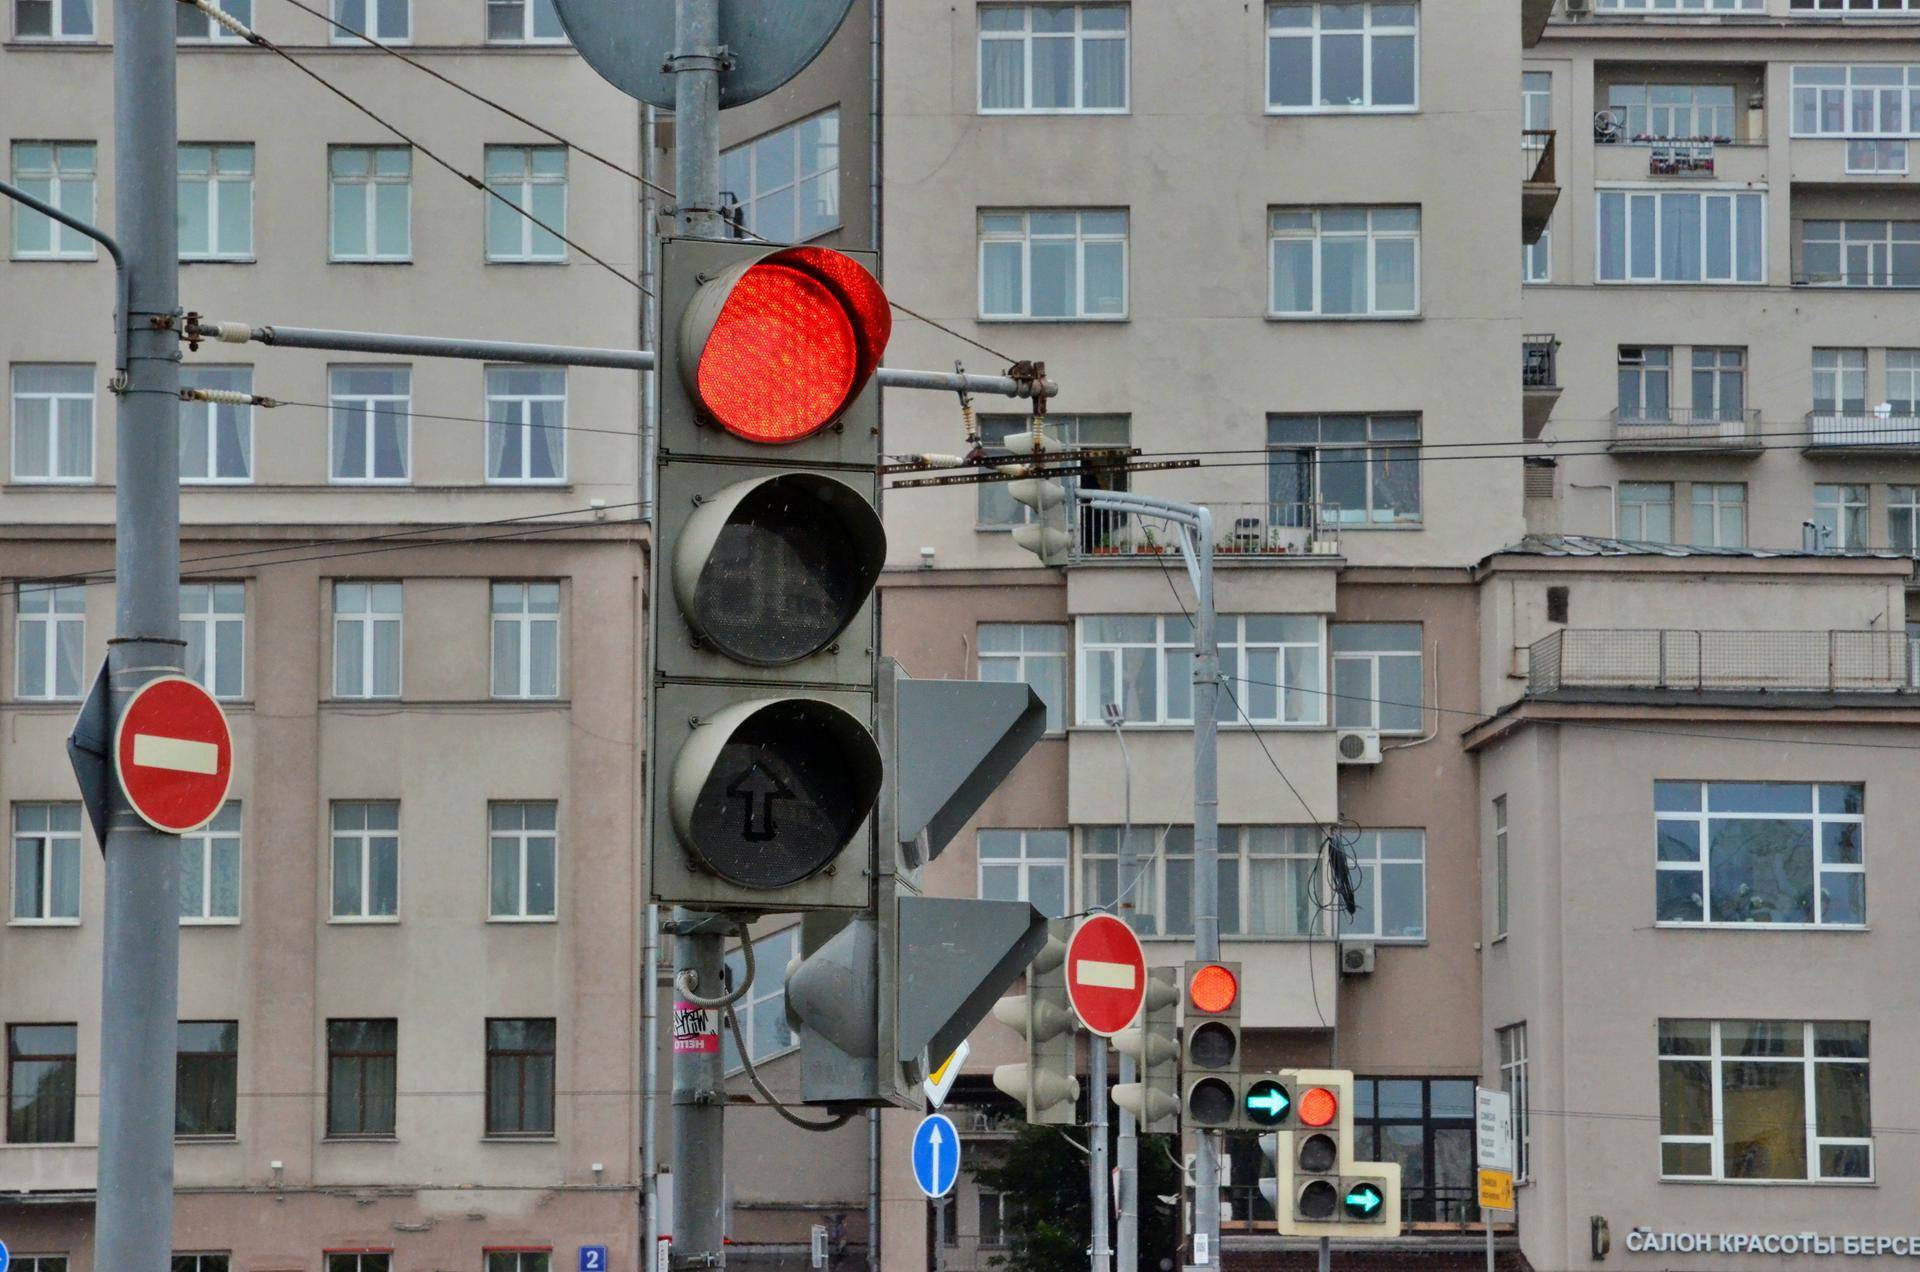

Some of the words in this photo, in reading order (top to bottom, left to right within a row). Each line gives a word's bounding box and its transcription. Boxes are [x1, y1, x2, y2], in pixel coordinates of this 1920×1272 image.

[674, 1040, 705, 1049] HELLO
[1626, 1232, 1711, 1252] САЛОН
[1719, 1233, 1836, 1254] КРАСОТЫ
[586, 1250, 599, 1269] 2
